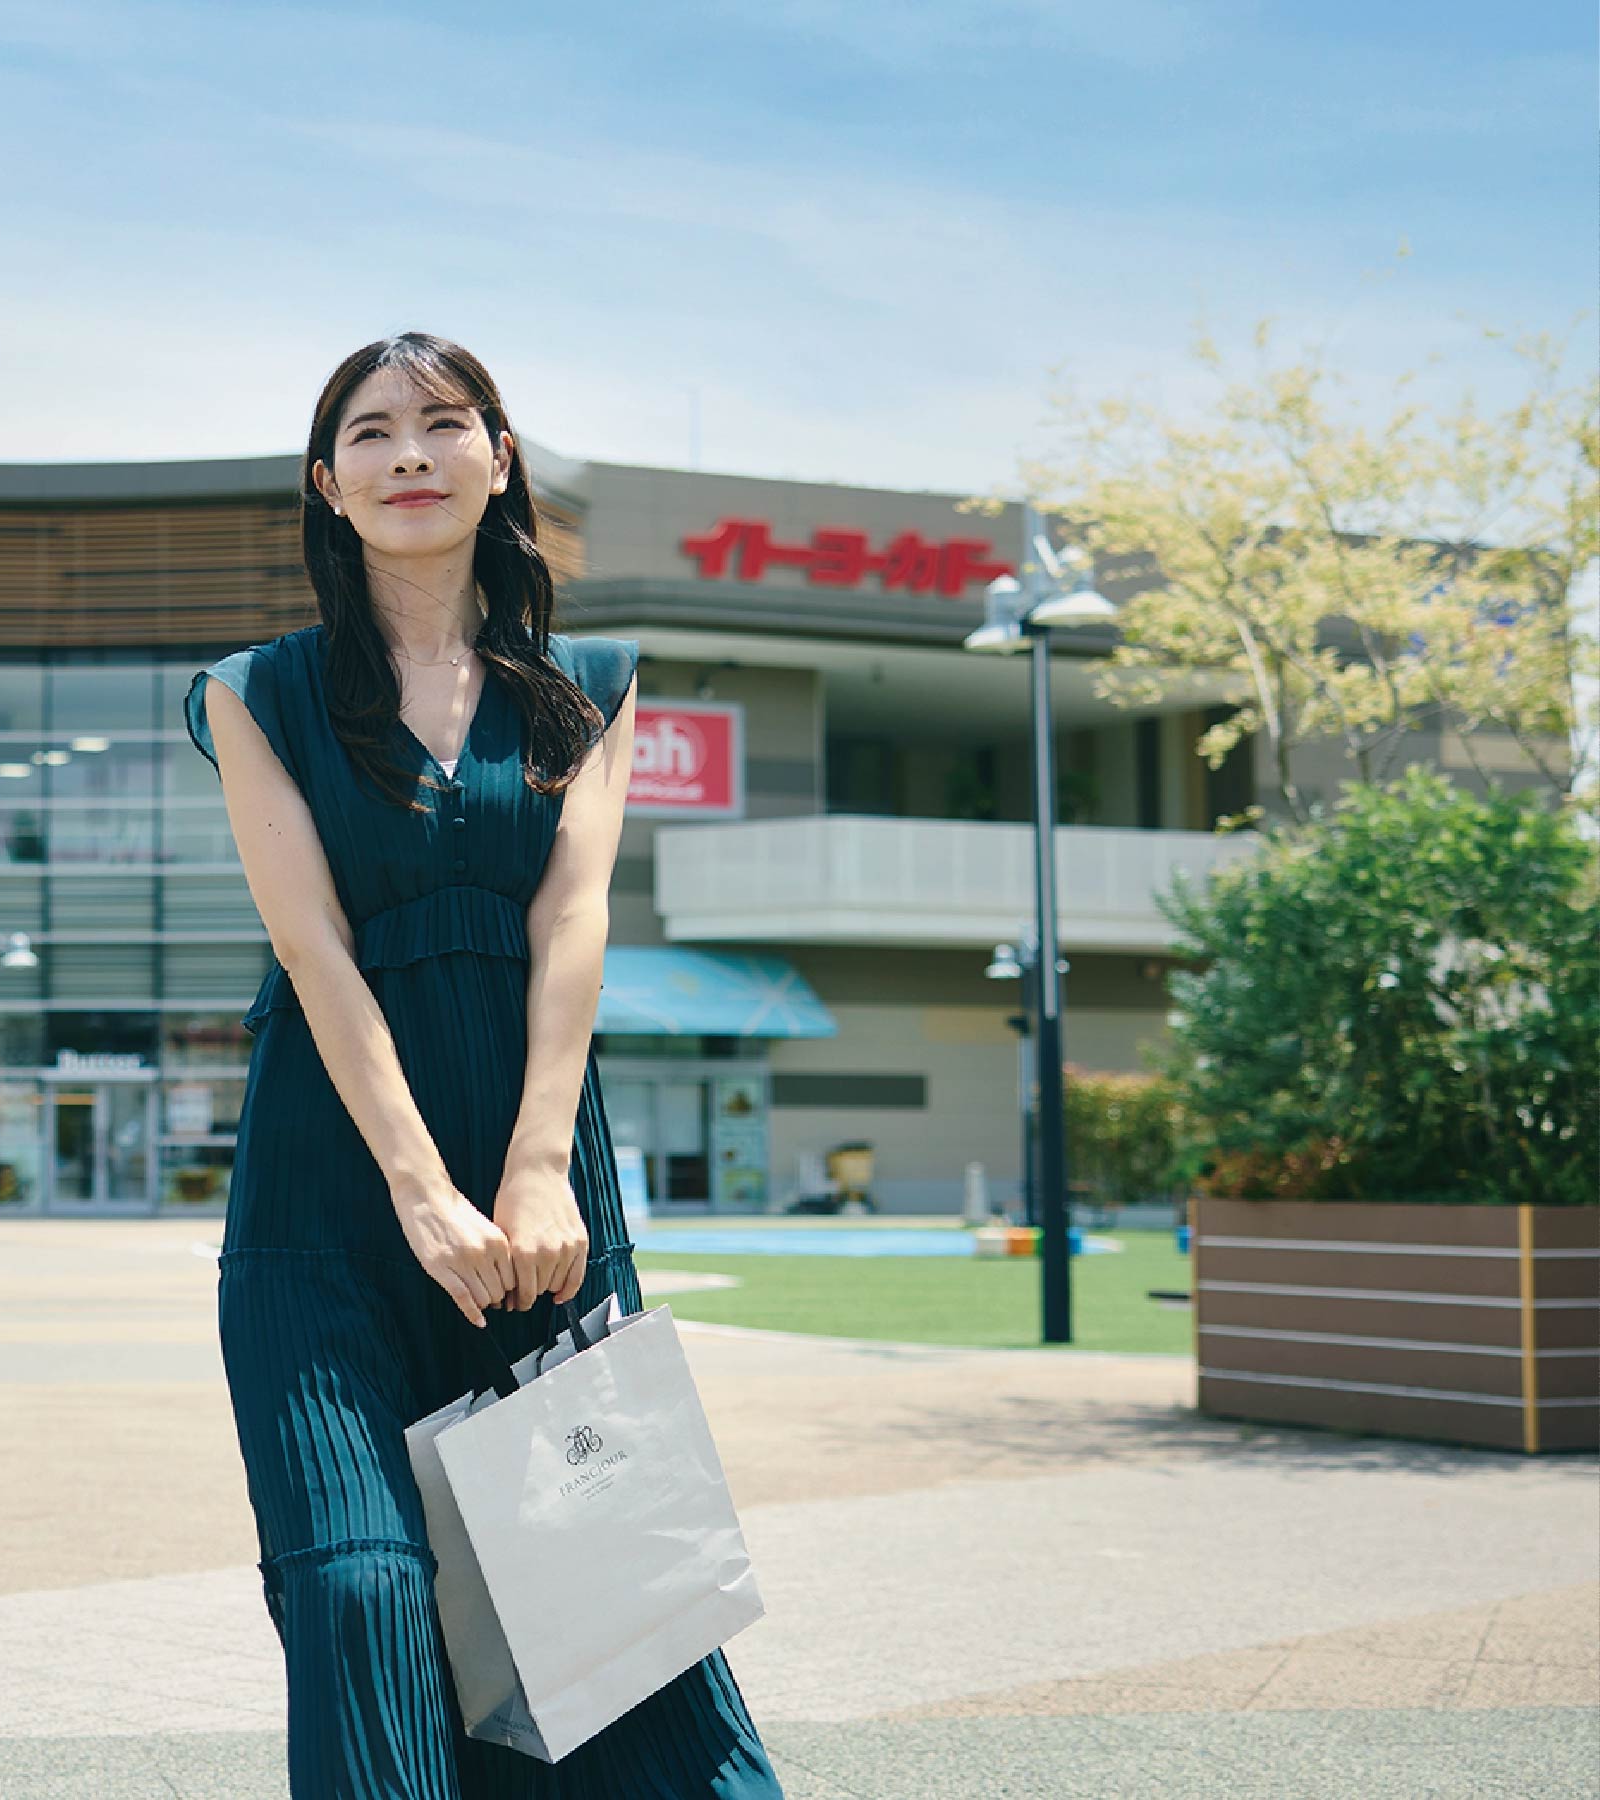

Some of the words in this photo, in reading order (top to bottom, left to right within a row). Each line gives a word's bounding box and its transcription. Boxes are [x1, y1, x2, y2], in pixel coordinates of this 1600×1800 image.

[681, 519, 1015, 597] イトーヨーカドー
